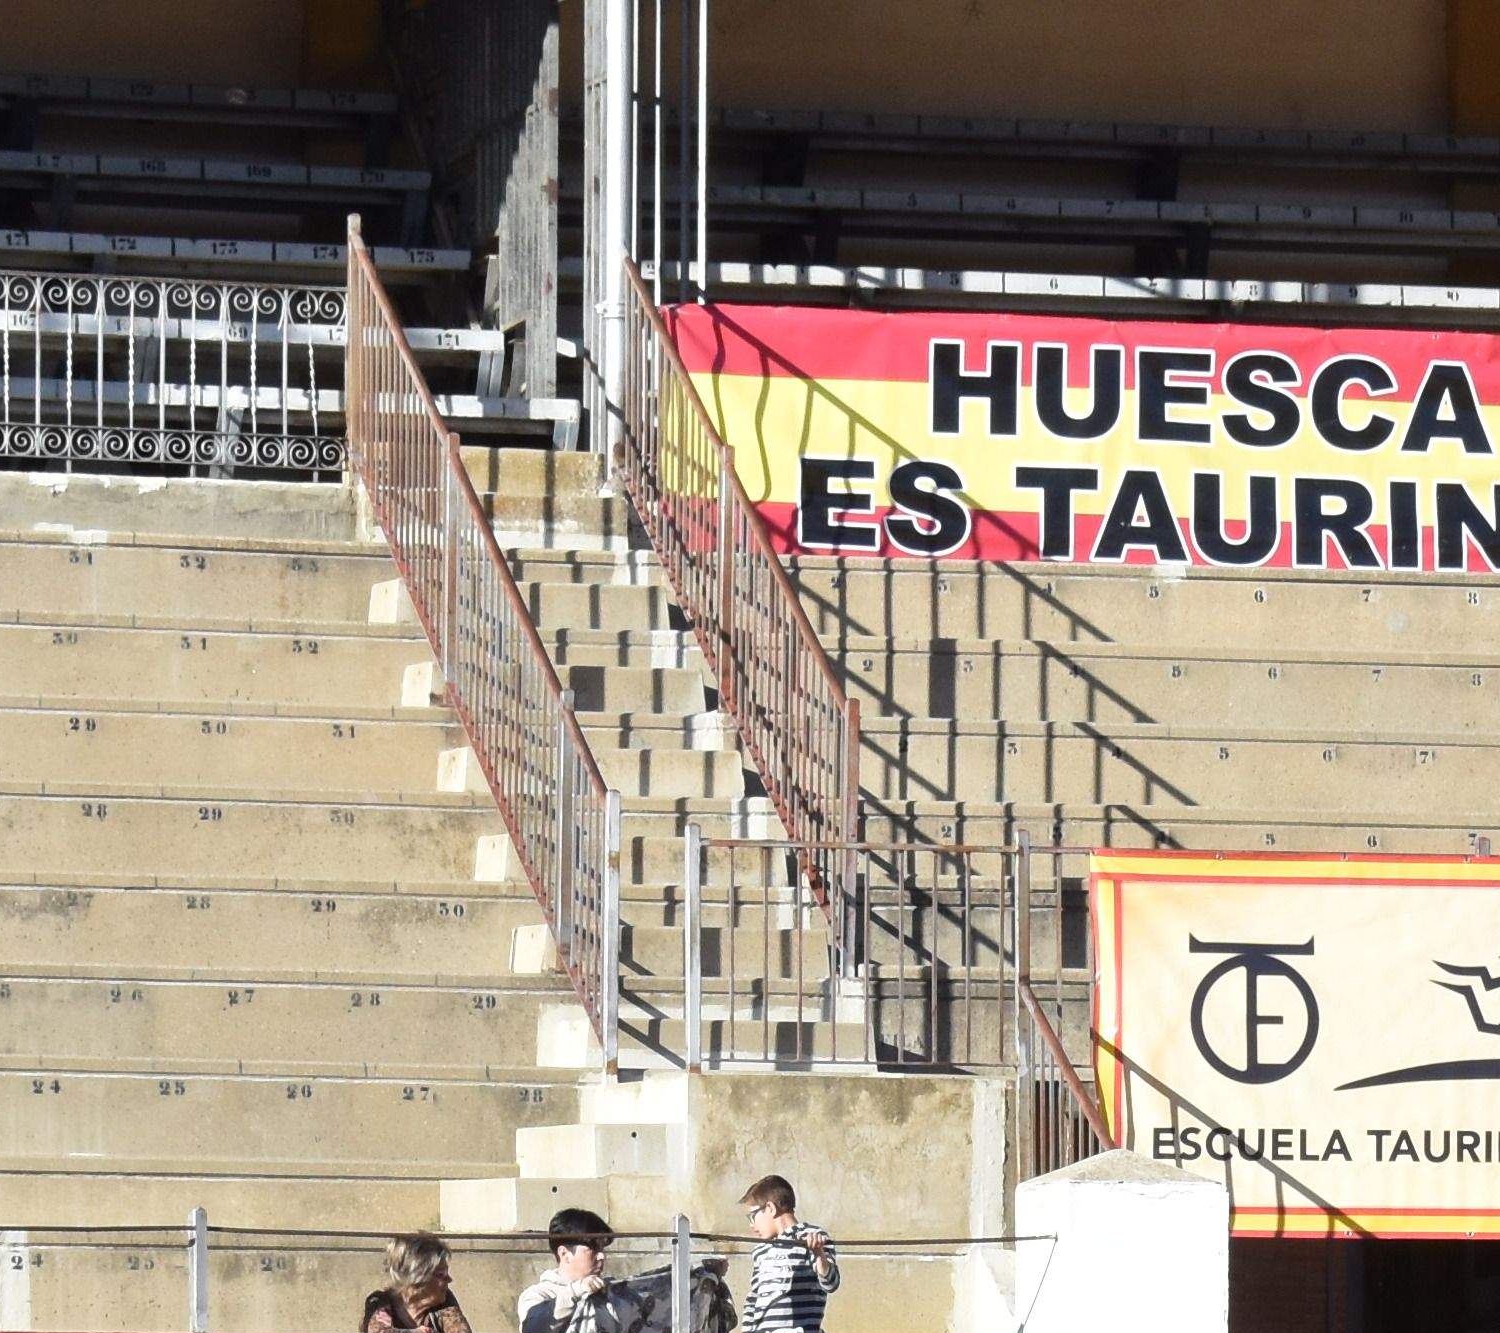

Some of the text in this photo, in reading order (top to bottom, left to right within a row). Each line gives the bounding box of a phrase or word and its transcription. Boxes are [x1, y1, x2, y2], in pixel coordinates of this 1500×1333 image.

[928, 339, 1495, 456] HUESCA
[799, 455, 973, 557] ES
[1254, 590, 1264, 603] 6
[1361, 588, 1372, 603] 7
[1468, 591, 1478, 605] 8
[1267, 667, 1278, 680] 6
[1471, 673, 1482, 687] 8
[69, 717, 97, 732] 29
[1322, 746, 1333, 762] 6
[1418, 749, 1430, 764] 7
[198, 806, 223, 821] 29
[1367, 835, 1378, 848] 6
[186, 895, 211, 910] 28
[311, 899, 337, 913] 29
[350, 992, 381, 1008] 28
[472, 995, 497, 1010] 29
[32, 1079, 61, 1095] 24
[286, 1084, 312, 1100] 26
[518, 1088, 544, 1103] 28
[1152, 1127, 1353, 1163] ESCUELA
[11, 1252, 44, 1270] 24
